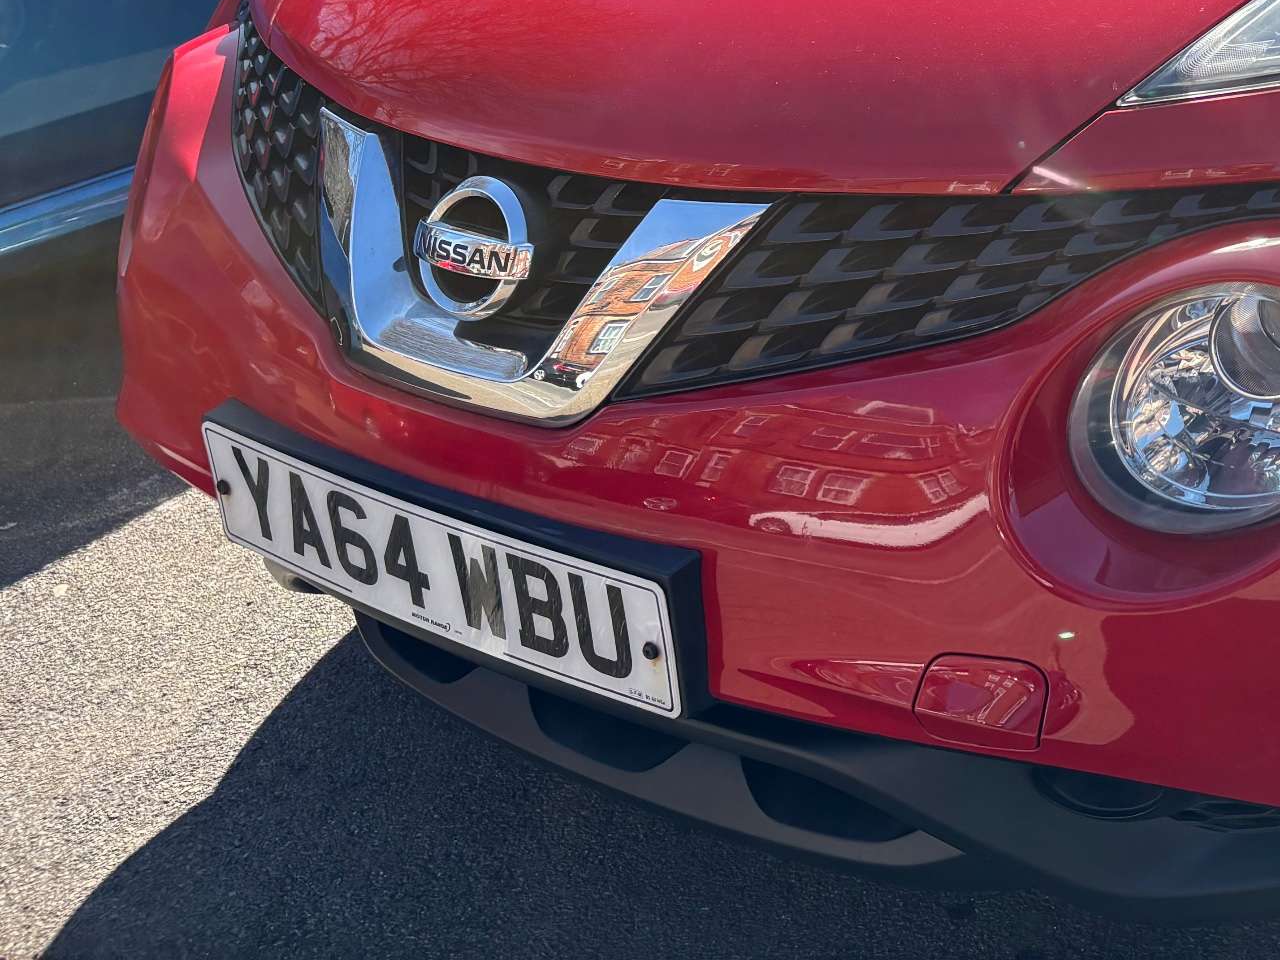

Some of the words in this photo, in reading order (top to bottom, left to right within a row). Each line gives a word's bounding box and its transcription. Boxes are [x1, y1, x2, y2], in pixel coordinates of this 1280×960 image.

[424, 233, 511, 273] NISSAN
[231, 445, 430, 610] YA64
[447, 531, 633, 680] WBU
